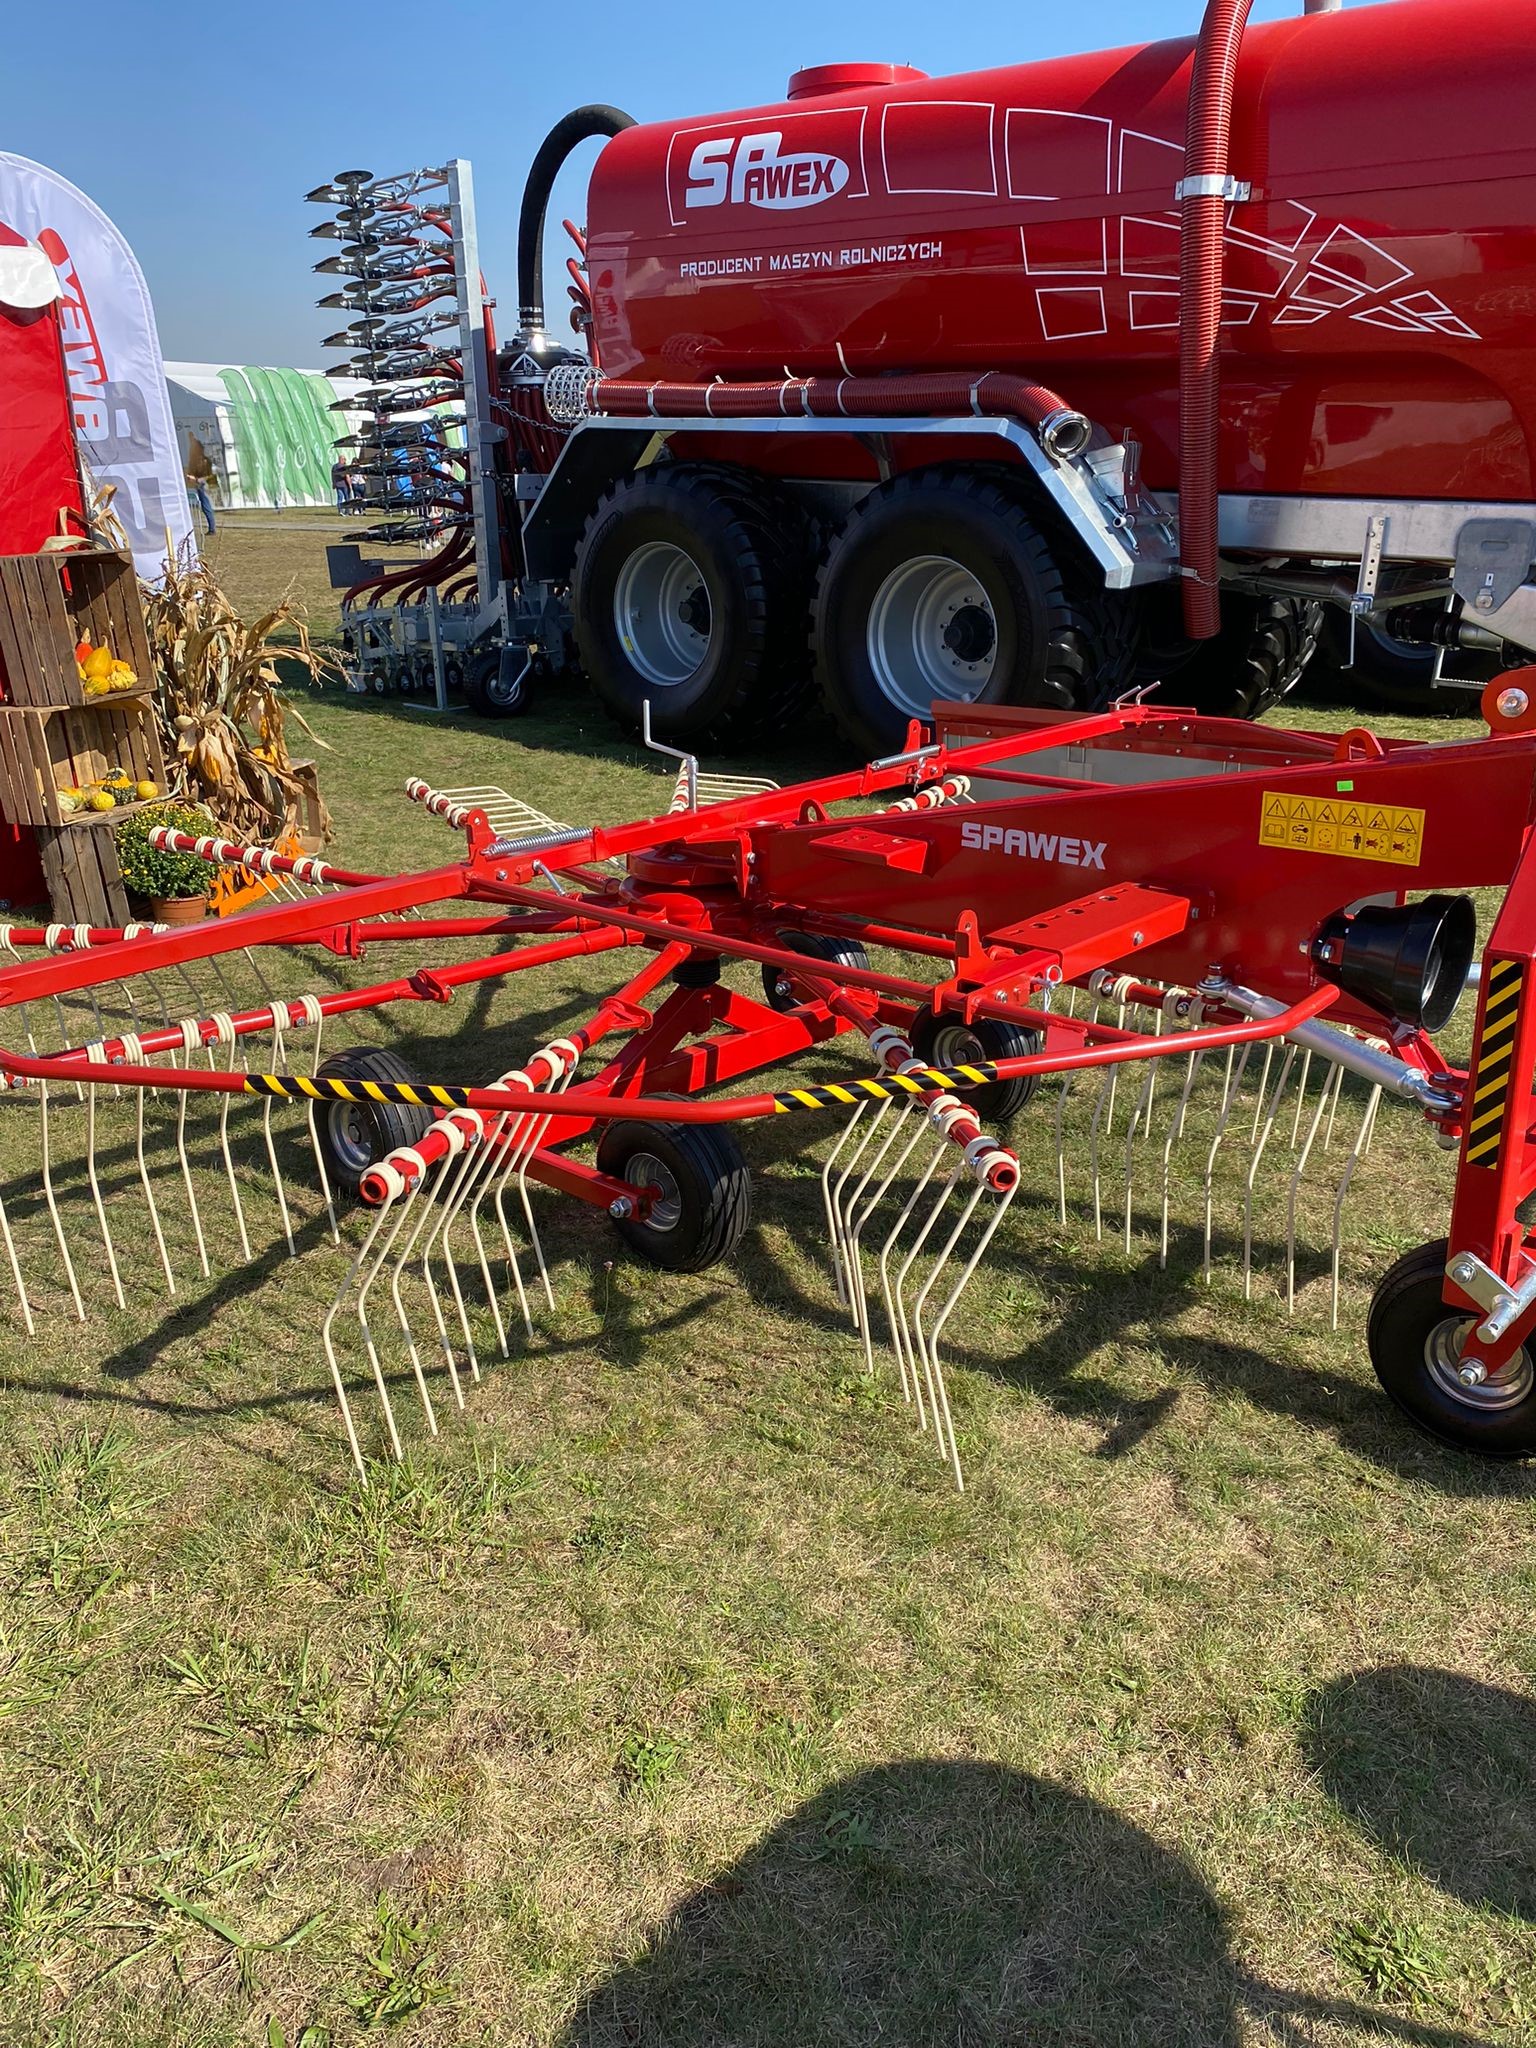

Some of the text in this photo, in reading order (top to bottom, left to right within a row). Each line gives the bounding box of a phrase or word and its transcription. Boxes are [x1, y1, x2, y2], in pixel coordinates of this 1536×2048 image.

[680, 241, 943, 278] PRODUCENT MASZYN ROLNICZYCH
[961, 822, 1108, 871] SPAWEX
